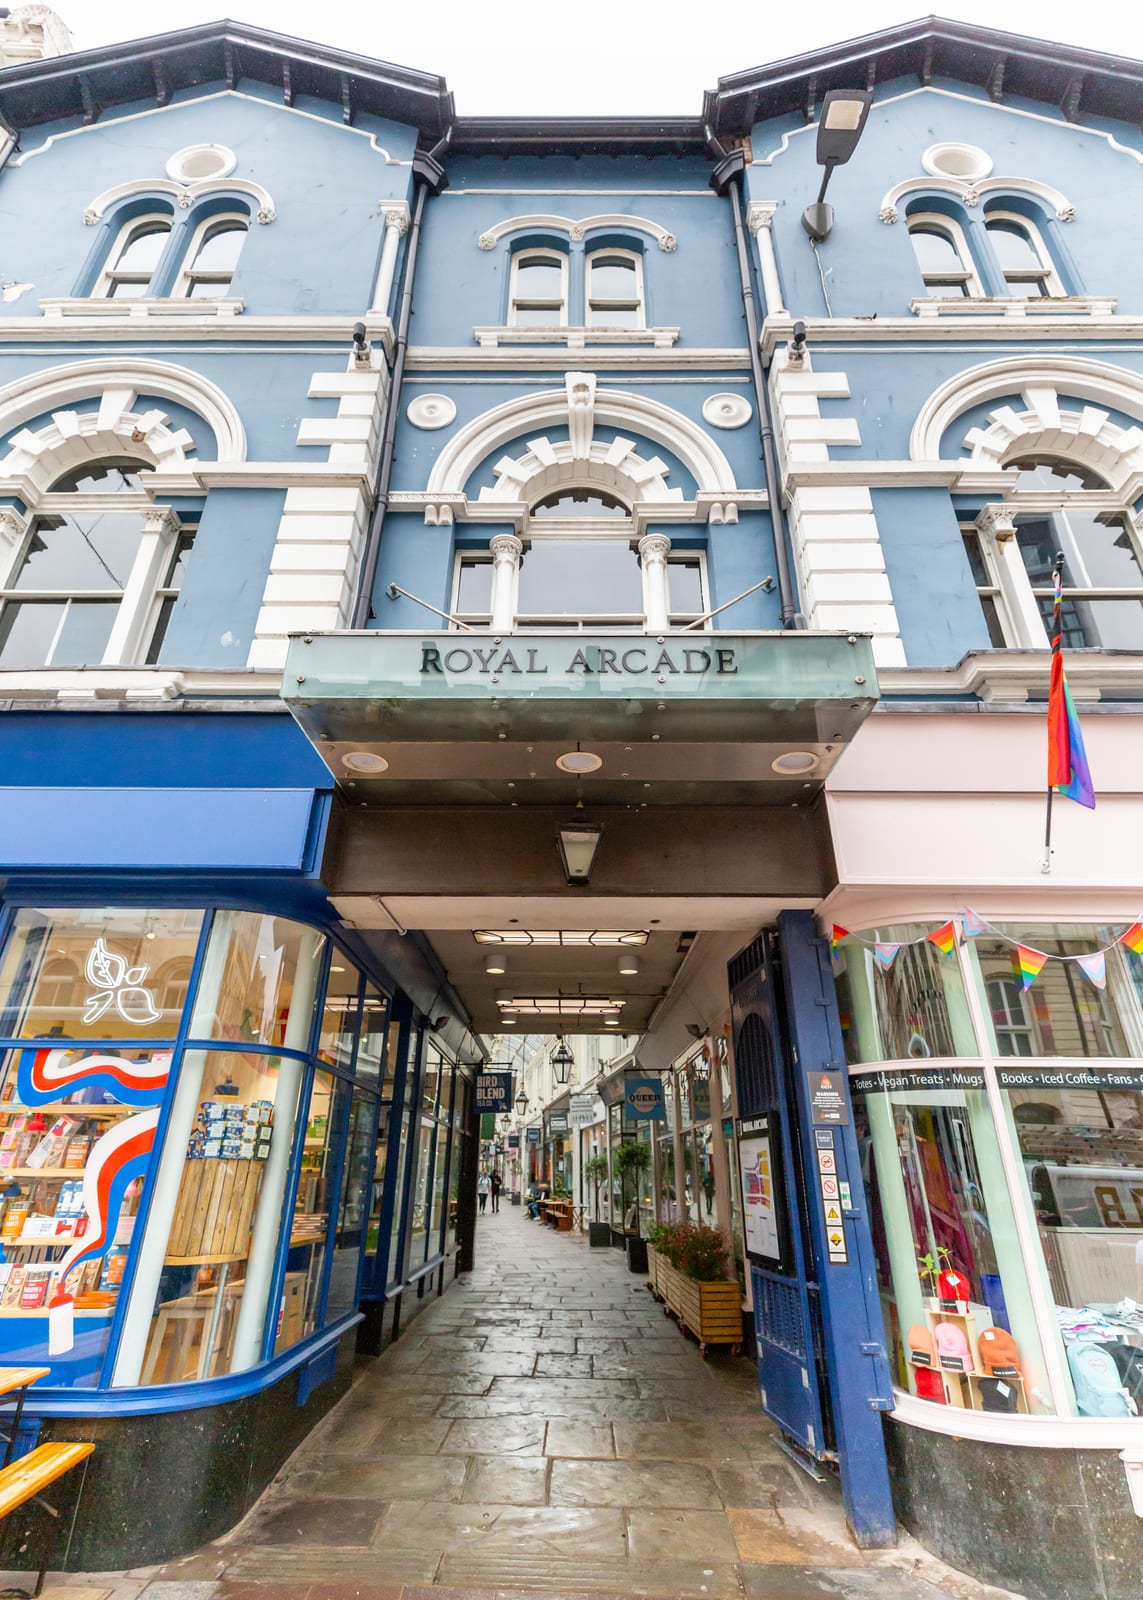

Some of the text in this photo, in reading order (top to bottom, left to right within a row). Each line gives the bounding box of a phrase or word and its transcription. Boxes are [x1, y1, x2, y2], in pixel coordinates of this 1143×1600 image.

[418, 648, 738, 674] ROYAL ARCADE
[476, 1075, 498, 1088] BIRD
[855, 1073, 983, 1090] Totes Vegan Treats Mugs
[1000, 1072, 1034, 1084] Books
[1041, 1072, 1064, 1084] Iced
[1065, 1072, 1100, 1084] Coffee
[1107, 1073, 1133, 1085] Fans
[476, 1087, 506, 1100] BLEND
[629, 1094, 662, 1103] QUEER
